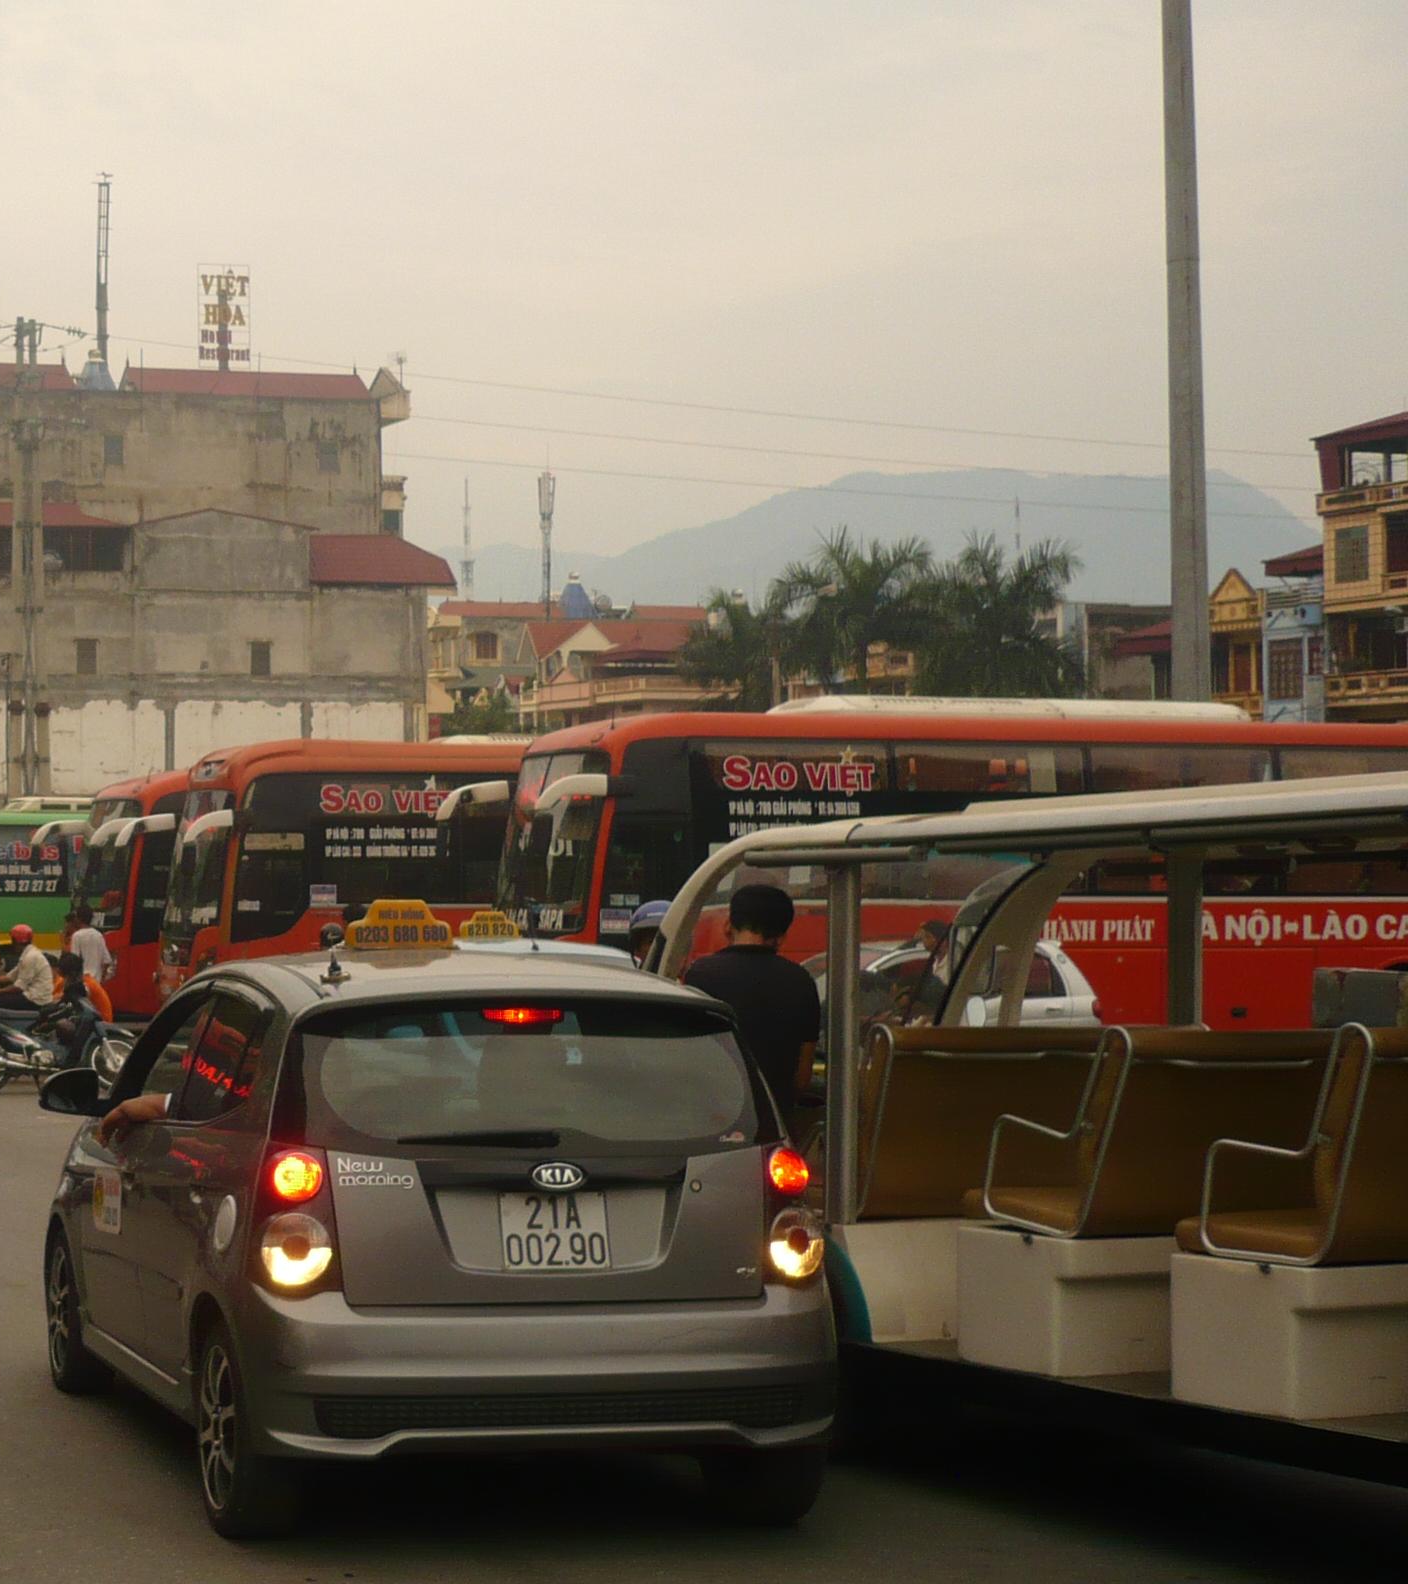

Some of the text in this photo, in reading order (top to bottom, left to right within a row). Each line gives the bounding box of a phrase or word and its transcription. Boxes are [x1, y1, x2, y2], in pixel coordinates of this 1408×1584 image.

[201, 269, 250, 300] VIỆT
[201, 329, 232, 344] Hol
[199, 346, 250, 361] Resrant
[723, 755, 875, 797] SAO VIỆT
[320, 784, 384, 813] SAO
[1040, 914, 1097, 942] HÀNH
[1201, 910, 1219, 941] À
[1224, 908, 1282, 947] NỘI
[1303, 909, 1369, 940] LÀO
[337, 1157, 383, 1174] New
[539, 1168, 576, 1183] KIA
[338, 1172, 415, 1190] morning
[524, 1194, 582, 1230] 21A
[505, 1231, 607, 1267] 002.90
